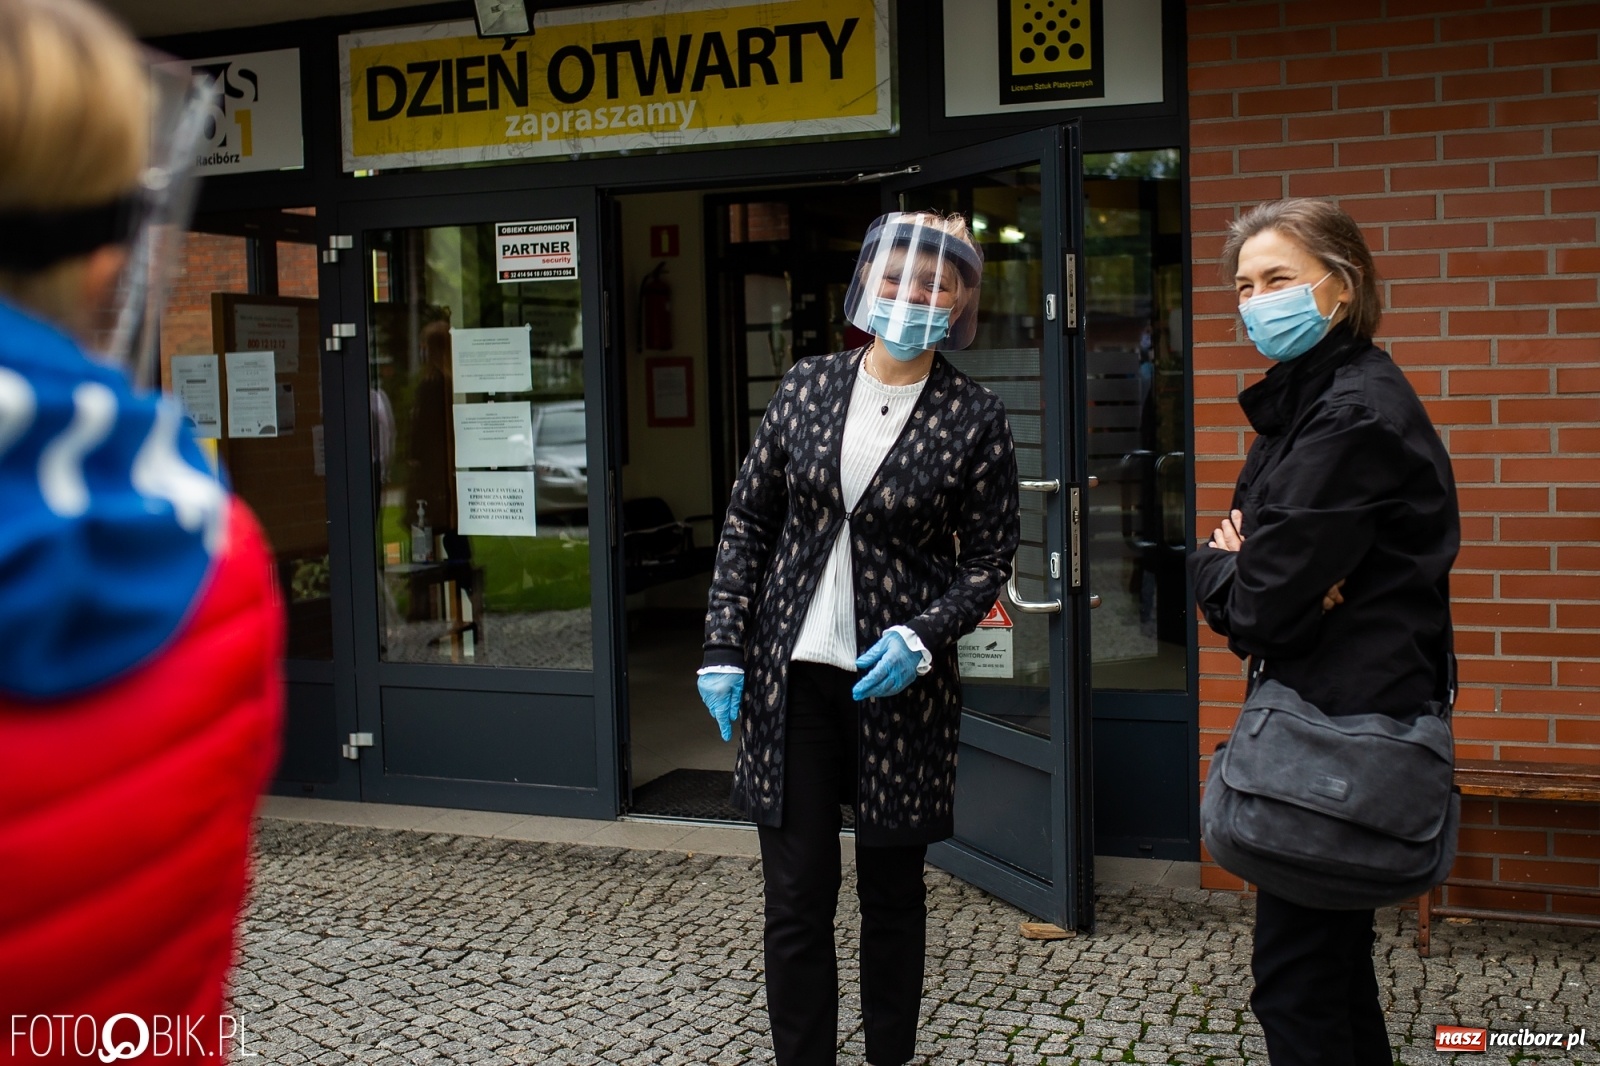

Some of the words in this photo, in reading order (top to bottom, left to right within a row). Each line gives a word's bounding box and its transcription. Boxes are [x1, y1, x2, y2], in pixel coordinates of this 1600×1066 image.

[365, 38, 529, 122] DZIEŃ
[546, 17, 859, 104] OTWARTY
[1011, 84, 1033, 92] Liceum
[1034, 82, 1052, 90] Sztuk
[1053, 79, 1094, 90] Plastycznych
[504, 99, 697, 141] zapraszamy
[195, 152, 240, 166] Racibórz
[501, 226, 528, 234] OBIEKT
[528, 223, 571, 232] CHRONIONY
[502, 241, 570, 256] PARTNER
[542, 256, 571, 264] security
